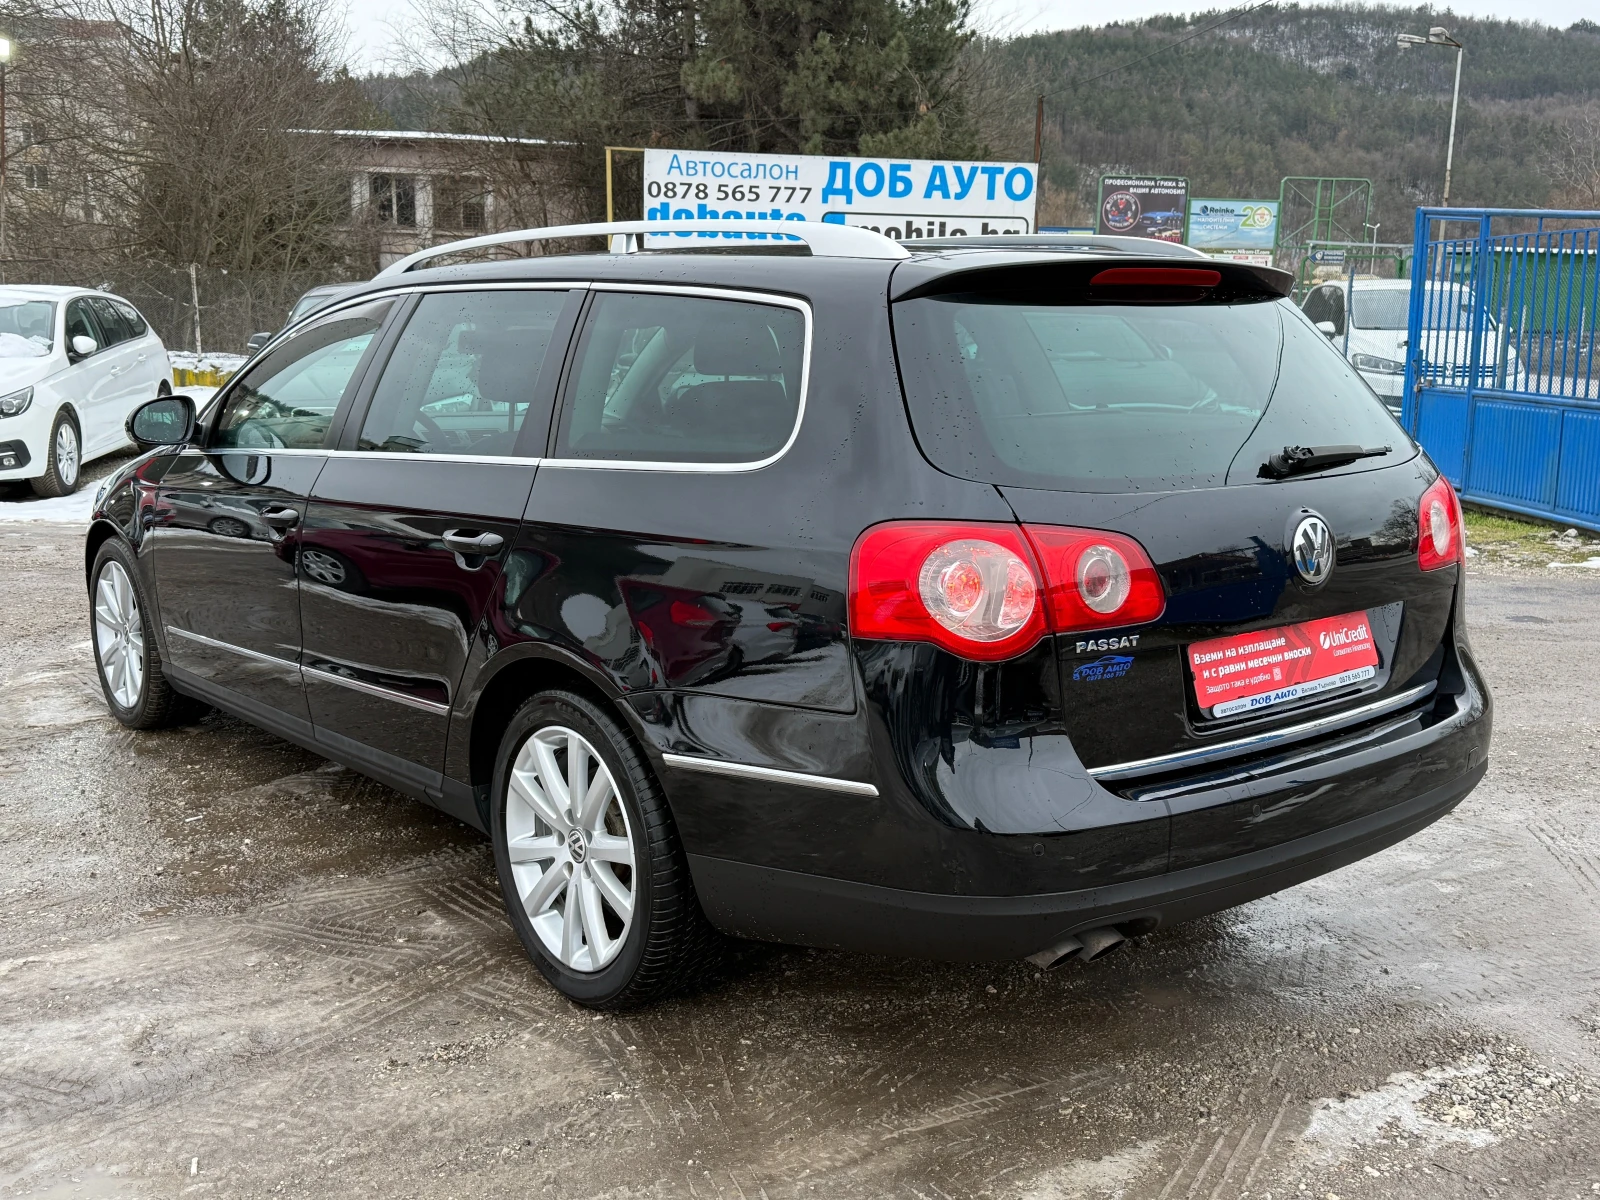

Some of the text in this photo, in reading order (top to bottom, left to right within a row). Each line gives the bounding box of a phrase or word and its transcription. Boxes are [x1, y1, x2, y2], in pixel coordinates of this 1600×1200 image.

[667, 154, 799, 180] Автосалон
[647, 181, 812, 204] 0878 565 777
[822, 161, 1034, 205] ДОБ АУТО
[1104, 179, 1155, 187] ПРОФЕСИОНАЛНА
[1209, 206, 1235, 214] Reinke
[1076, 635, 1139, 653] PASSAT
[1329, 625, 1368, 646] UniCredit
[1194, 637, 1286, 665] Вземи на изплащане
[1202, 647, 1312, 679] и с равни месечни вноски
[1361, 669, 1370, 678] 777
[1205, 683, 1230, 694] Защото
[1231, 680, 1245, 688] така
[1249, 673, 1271, 685] удобно
[1250, 688, 1298, 707] DOB AUTO
